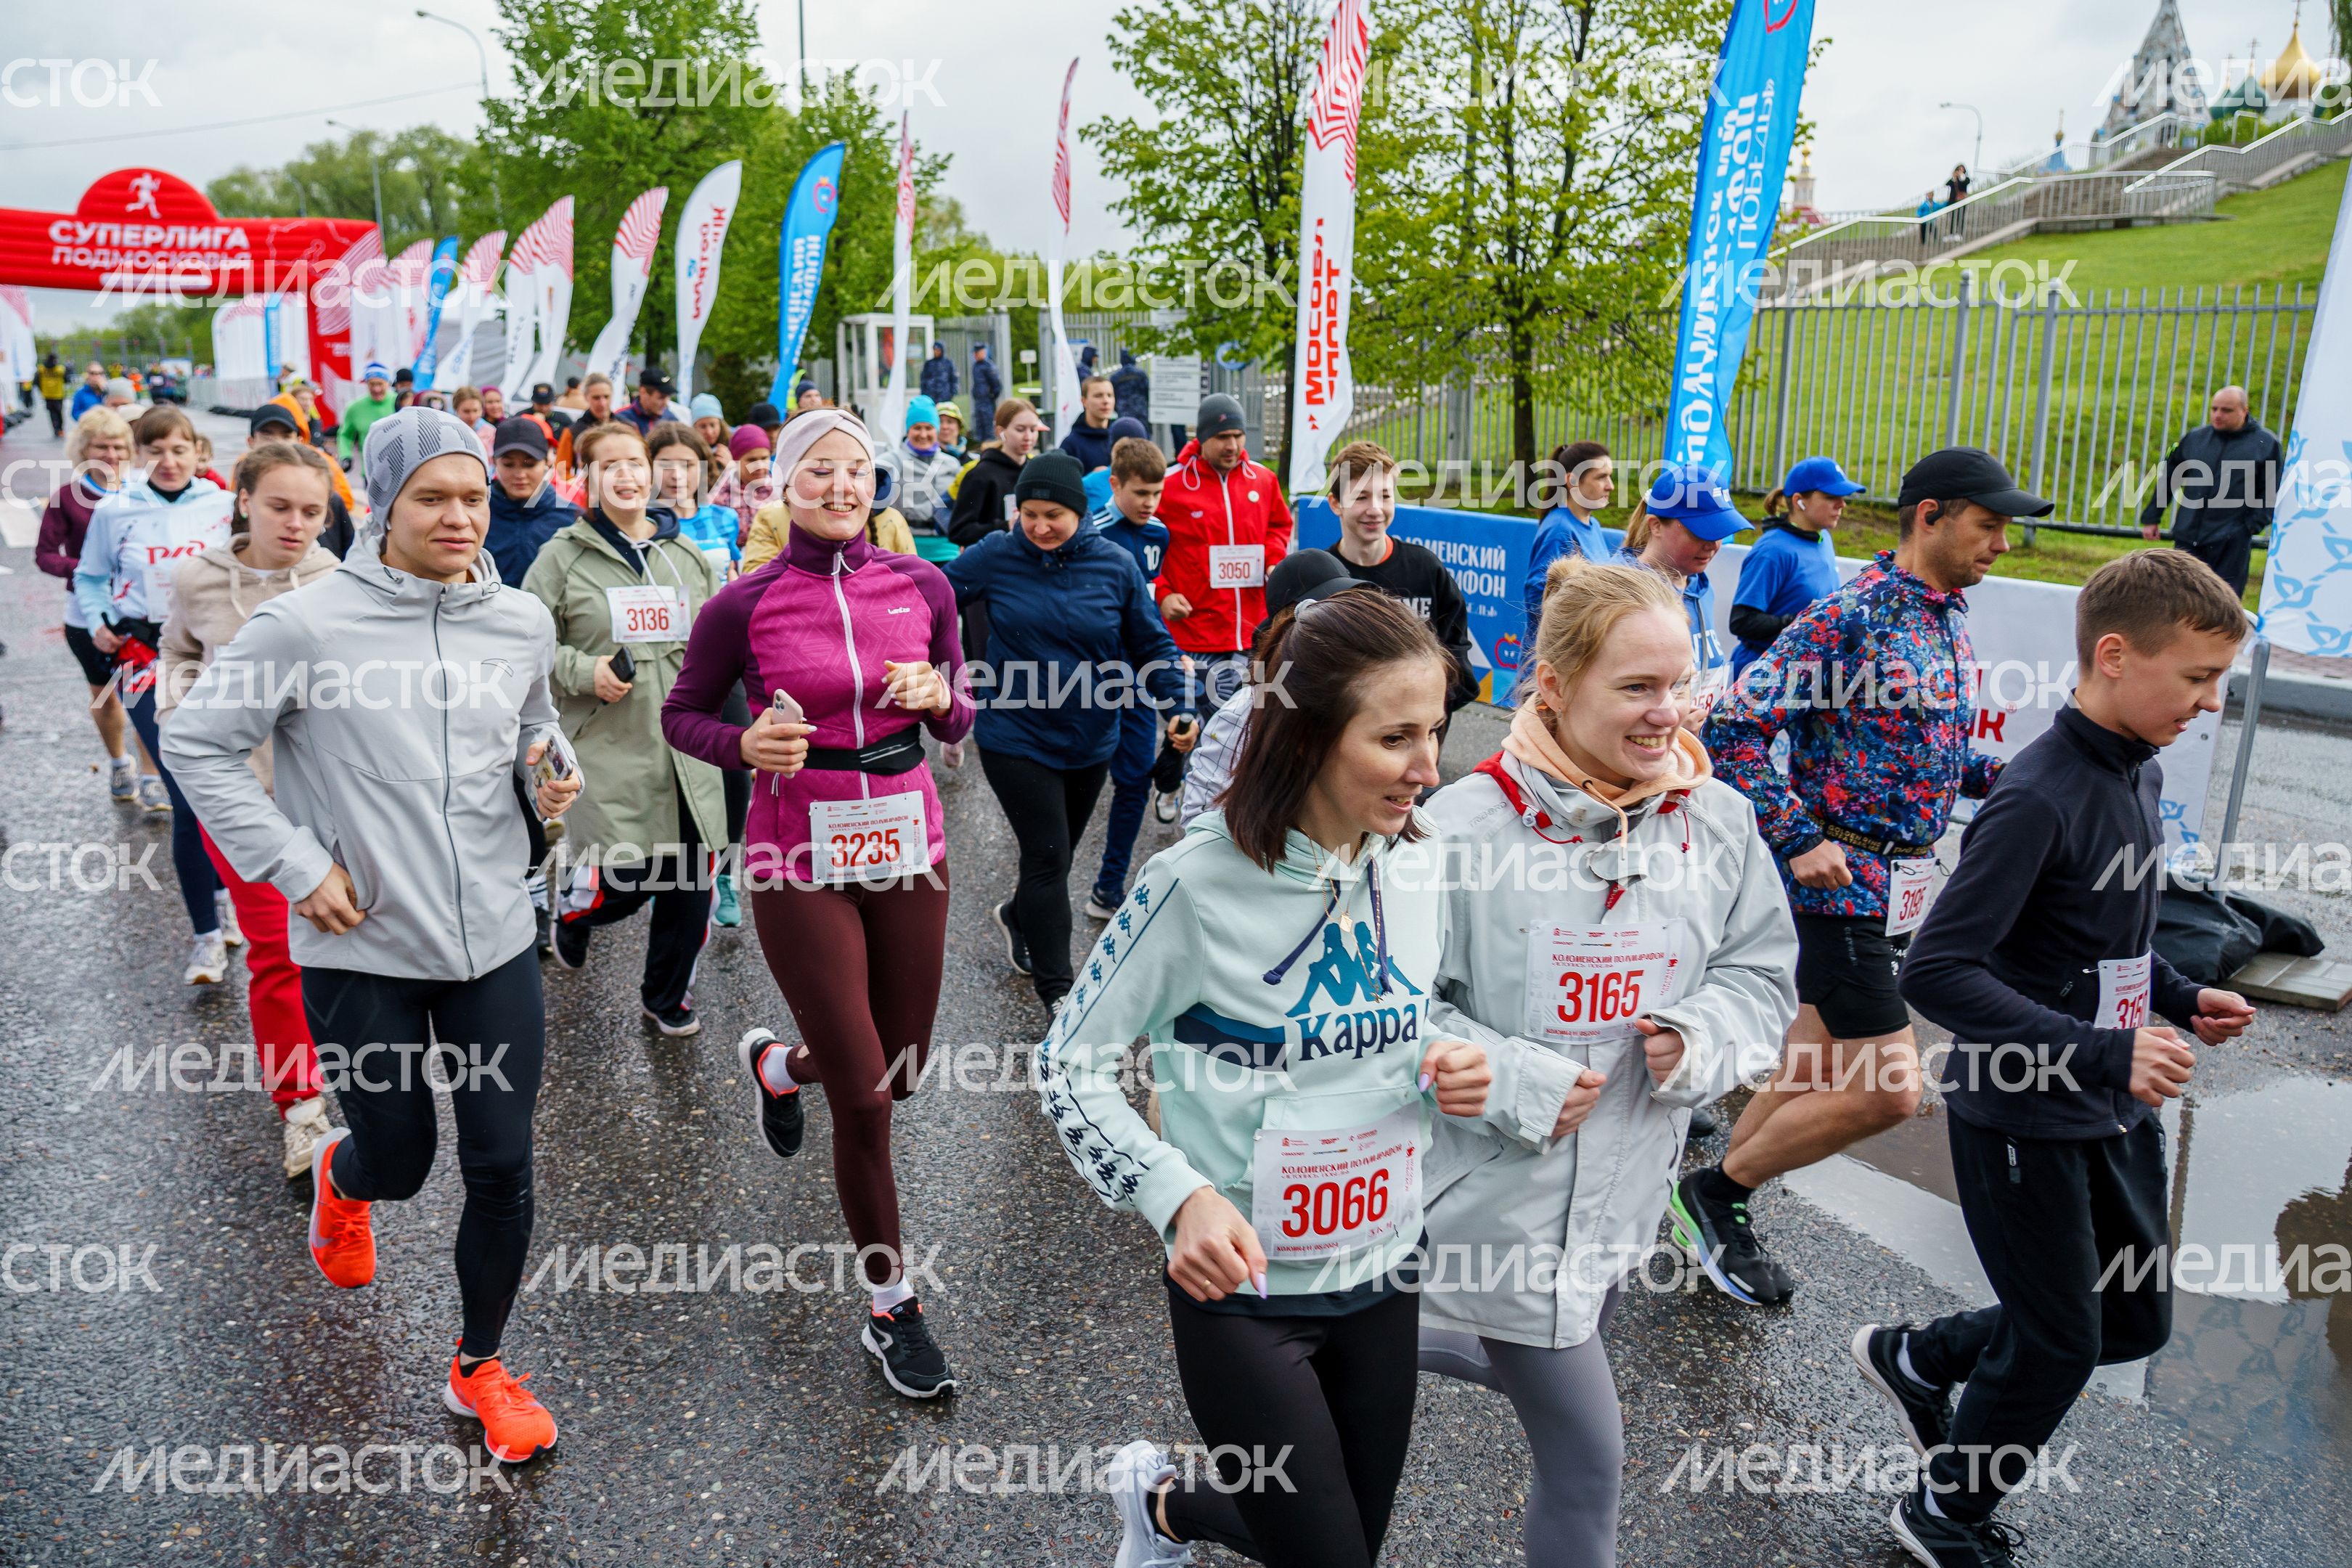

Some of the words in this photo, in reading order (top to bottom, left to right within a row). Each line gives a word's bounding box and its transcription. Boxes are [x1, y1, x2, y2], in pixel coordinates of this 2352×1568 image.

[49, 220, 250, 250] СУПЕРЛИГА
[51, 245, 253, 271] ПОДМОСКОВЬЯ
[1143, 545, 1161, 571] 10
[1219, 562, 1250, 579] 3050
[626, 607, 669, 632] 3136
[830, 828, 900, 868] 3235
[1557, 969, 1644, 1023] 3165
[1295, 999, 1420, 1063] Kappa
[1281, 1168, 1389, 1238] 3066
